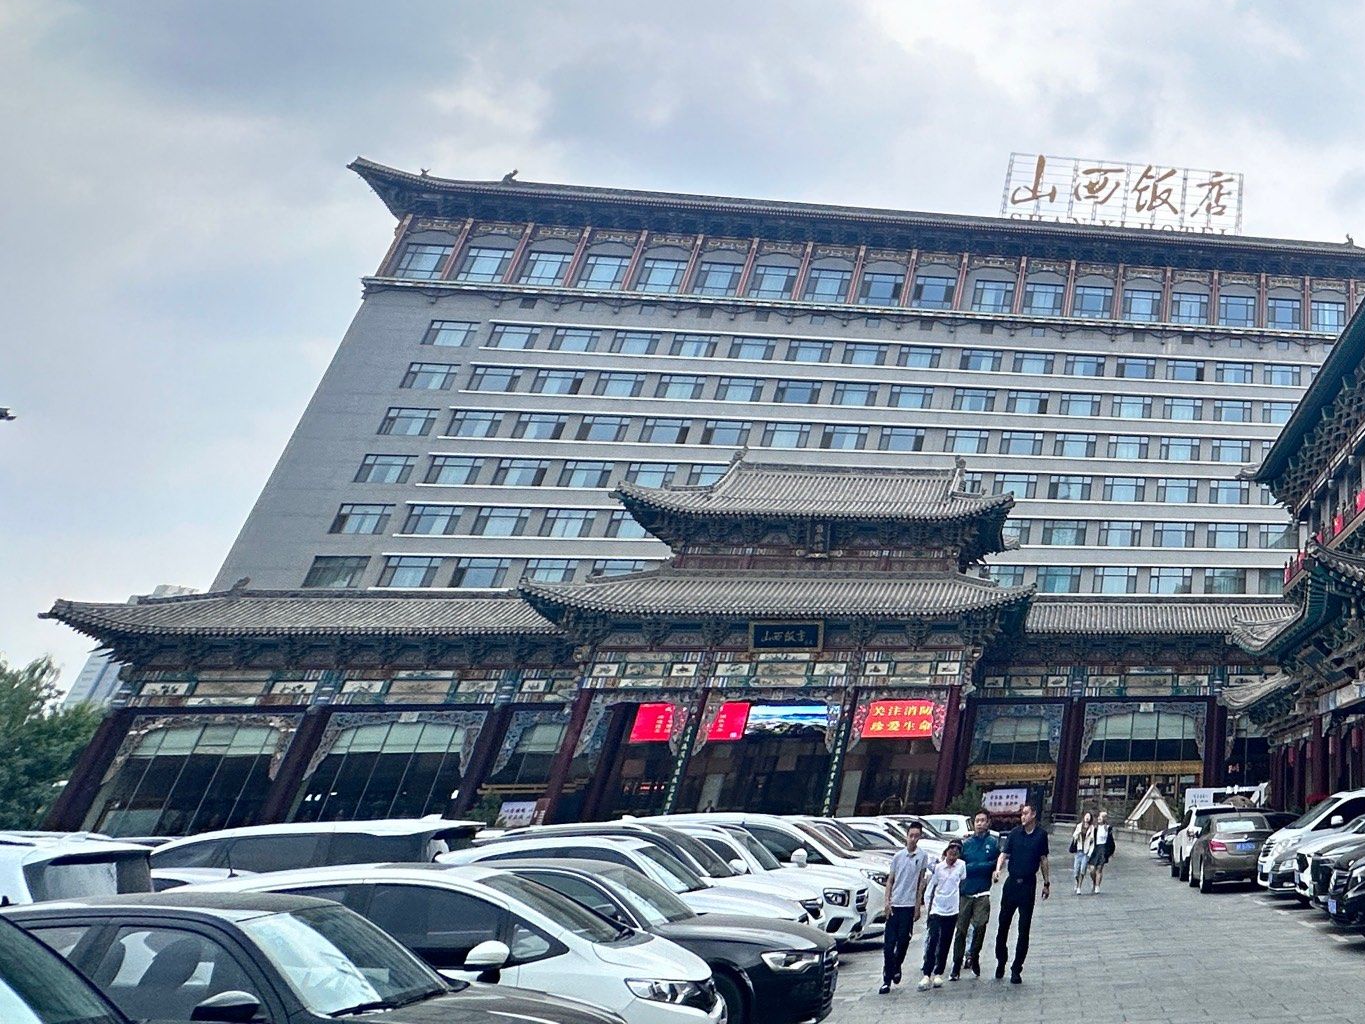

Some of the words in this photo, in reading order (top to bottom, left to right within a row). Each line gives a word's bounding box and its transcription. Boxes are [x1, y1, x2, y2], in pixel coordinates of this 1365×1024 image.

[1011, 154, 1235, 217] 山西饭店
[873, 705, 934, 717] 关注消防
[869, 720, 933, 732] 珍爱生命
